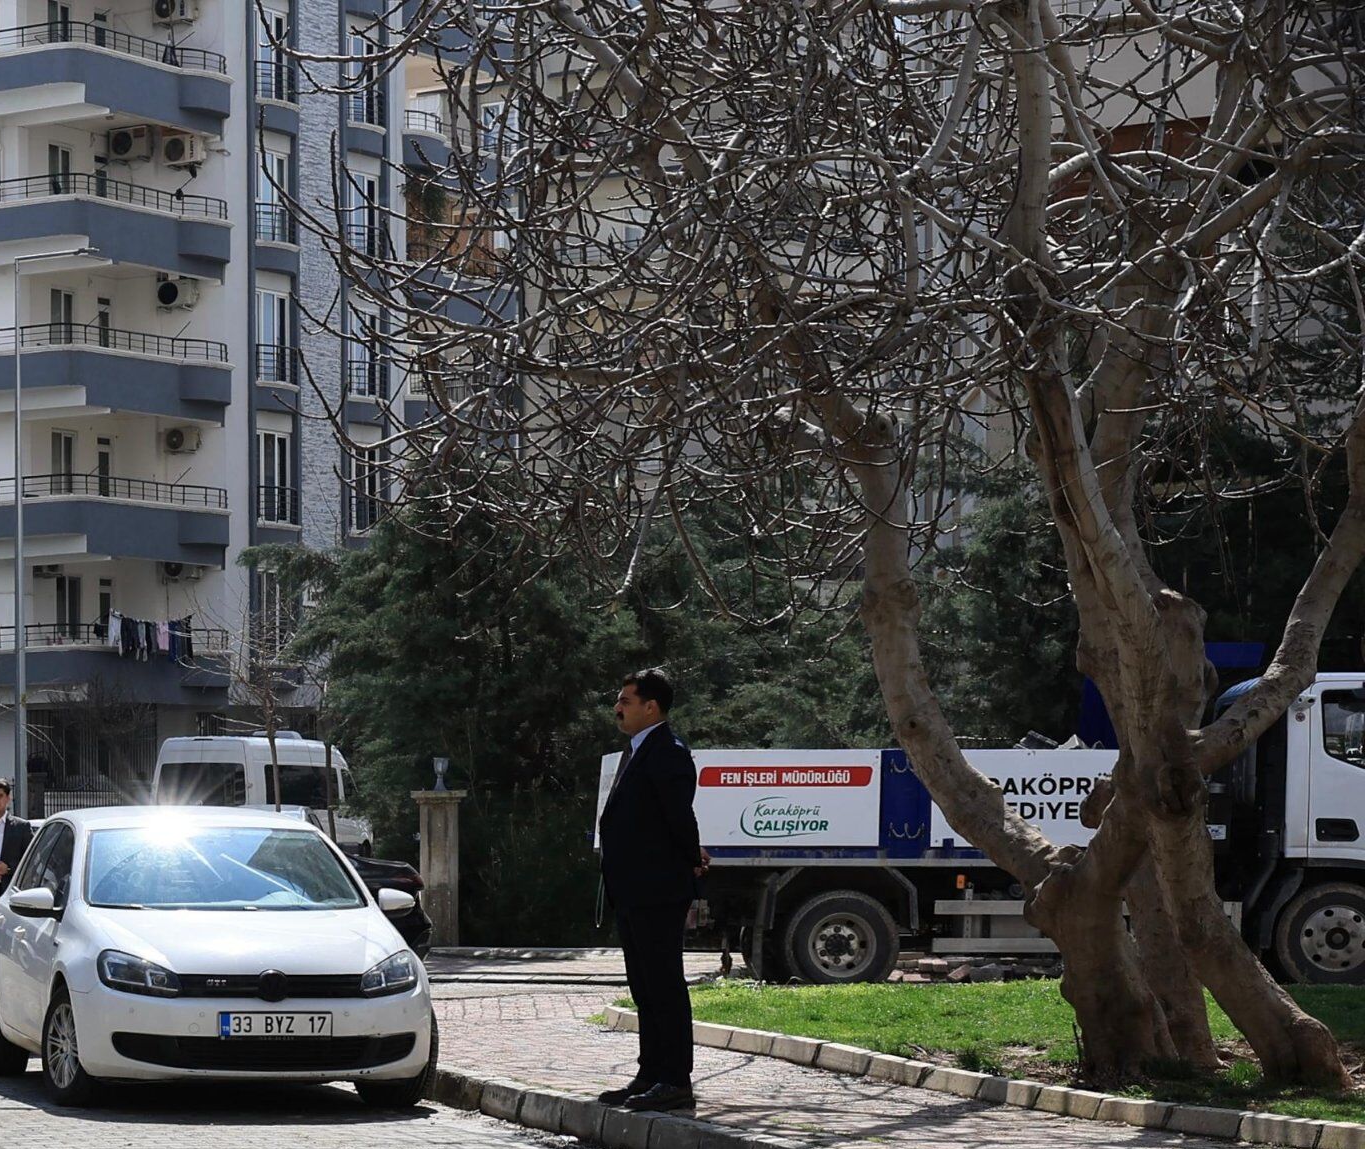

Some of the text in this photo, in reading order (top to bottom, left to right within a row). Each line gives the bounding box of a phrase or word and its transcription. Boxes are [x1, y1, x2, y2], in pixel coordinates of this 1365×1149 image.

[720, 769, 850, 787] FEN İŞLERİ MÜDÜRLÜĞÜ
[754, 803, 821, 820] Karaköprü
[753, 820, 829, 835] ÇALIŞIYOR
[232, 1016, 326, 1034] 33 BYZ 17
